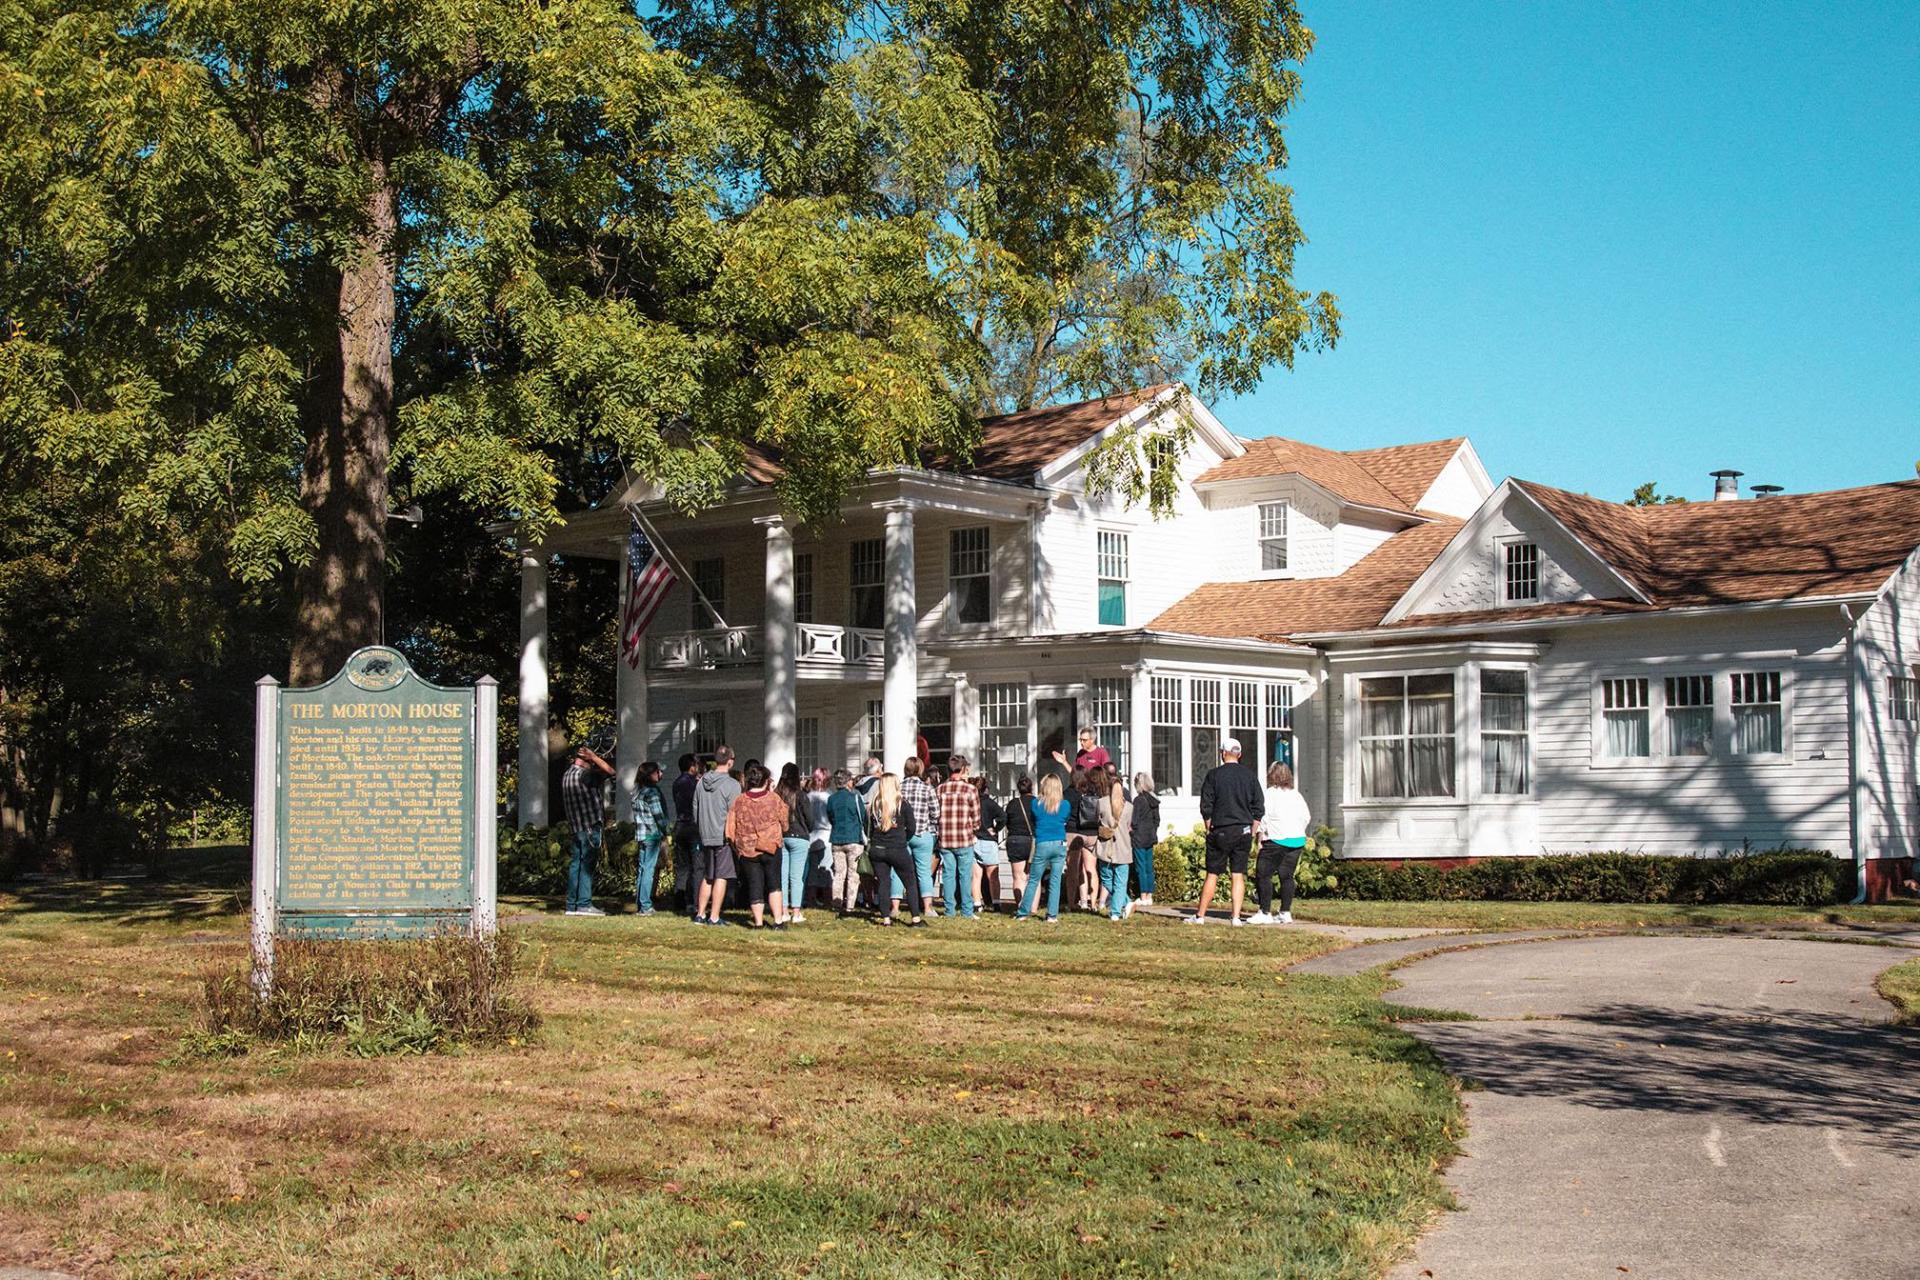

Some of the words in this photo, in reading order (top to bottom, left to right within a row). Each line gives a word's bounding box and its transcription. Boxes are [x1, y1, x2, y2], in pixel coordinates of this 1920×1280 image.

[290, 704, 324, 719] THE
[332, 704, 402, 719] MORTON
[409, 704, 463, 719] HOUSE
